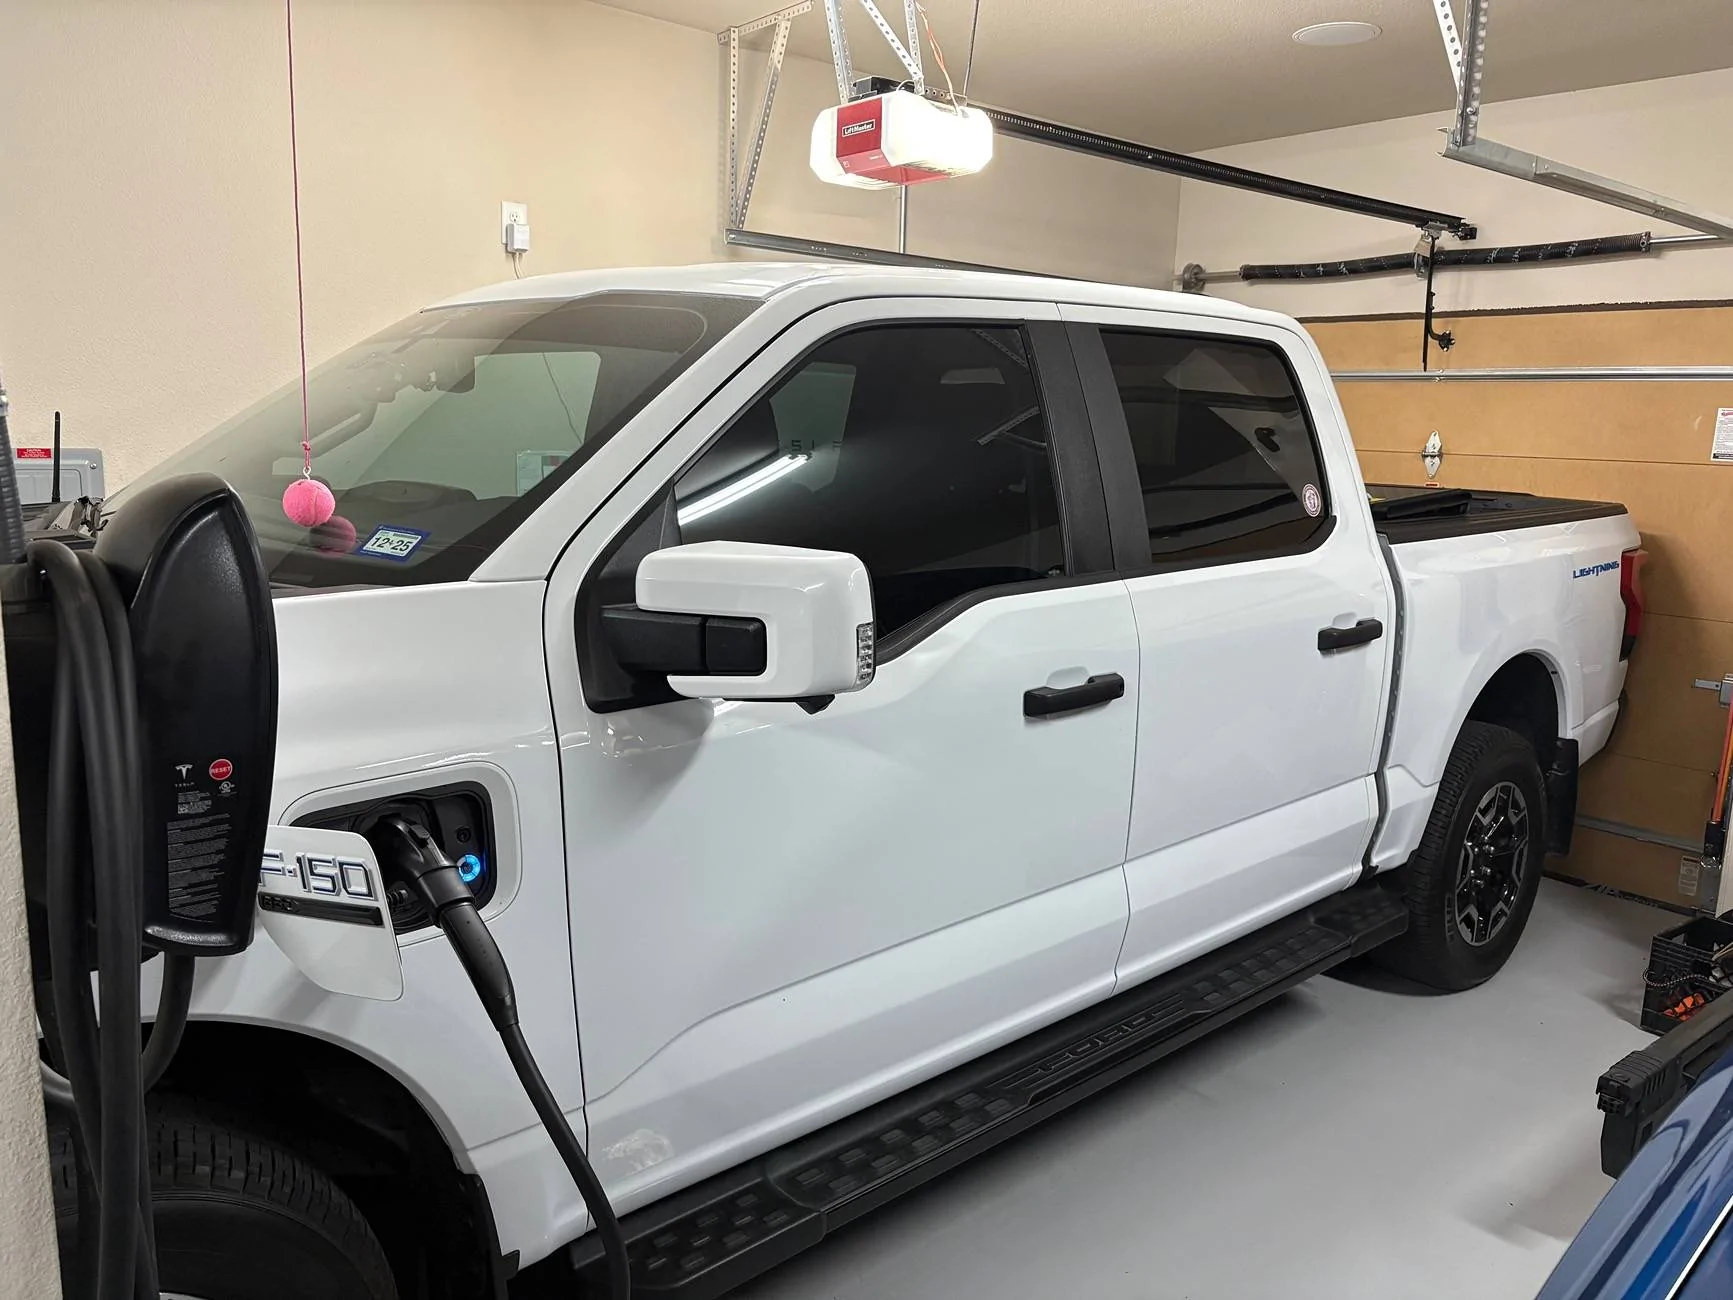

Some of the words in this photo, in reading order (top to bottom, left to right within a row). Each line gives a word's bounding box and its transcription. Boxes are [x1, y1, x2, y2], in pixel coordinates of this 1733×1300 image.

[844, 122, 873, 135] LiftMaster
[370, 536, 391, 548] 12
[390, 539, 414, 552] 25
[1572, 560, 1620, 579] LIGHTNING
[210, 766, 231, 774] RESET
[259, 849, 378, 901] F-150
